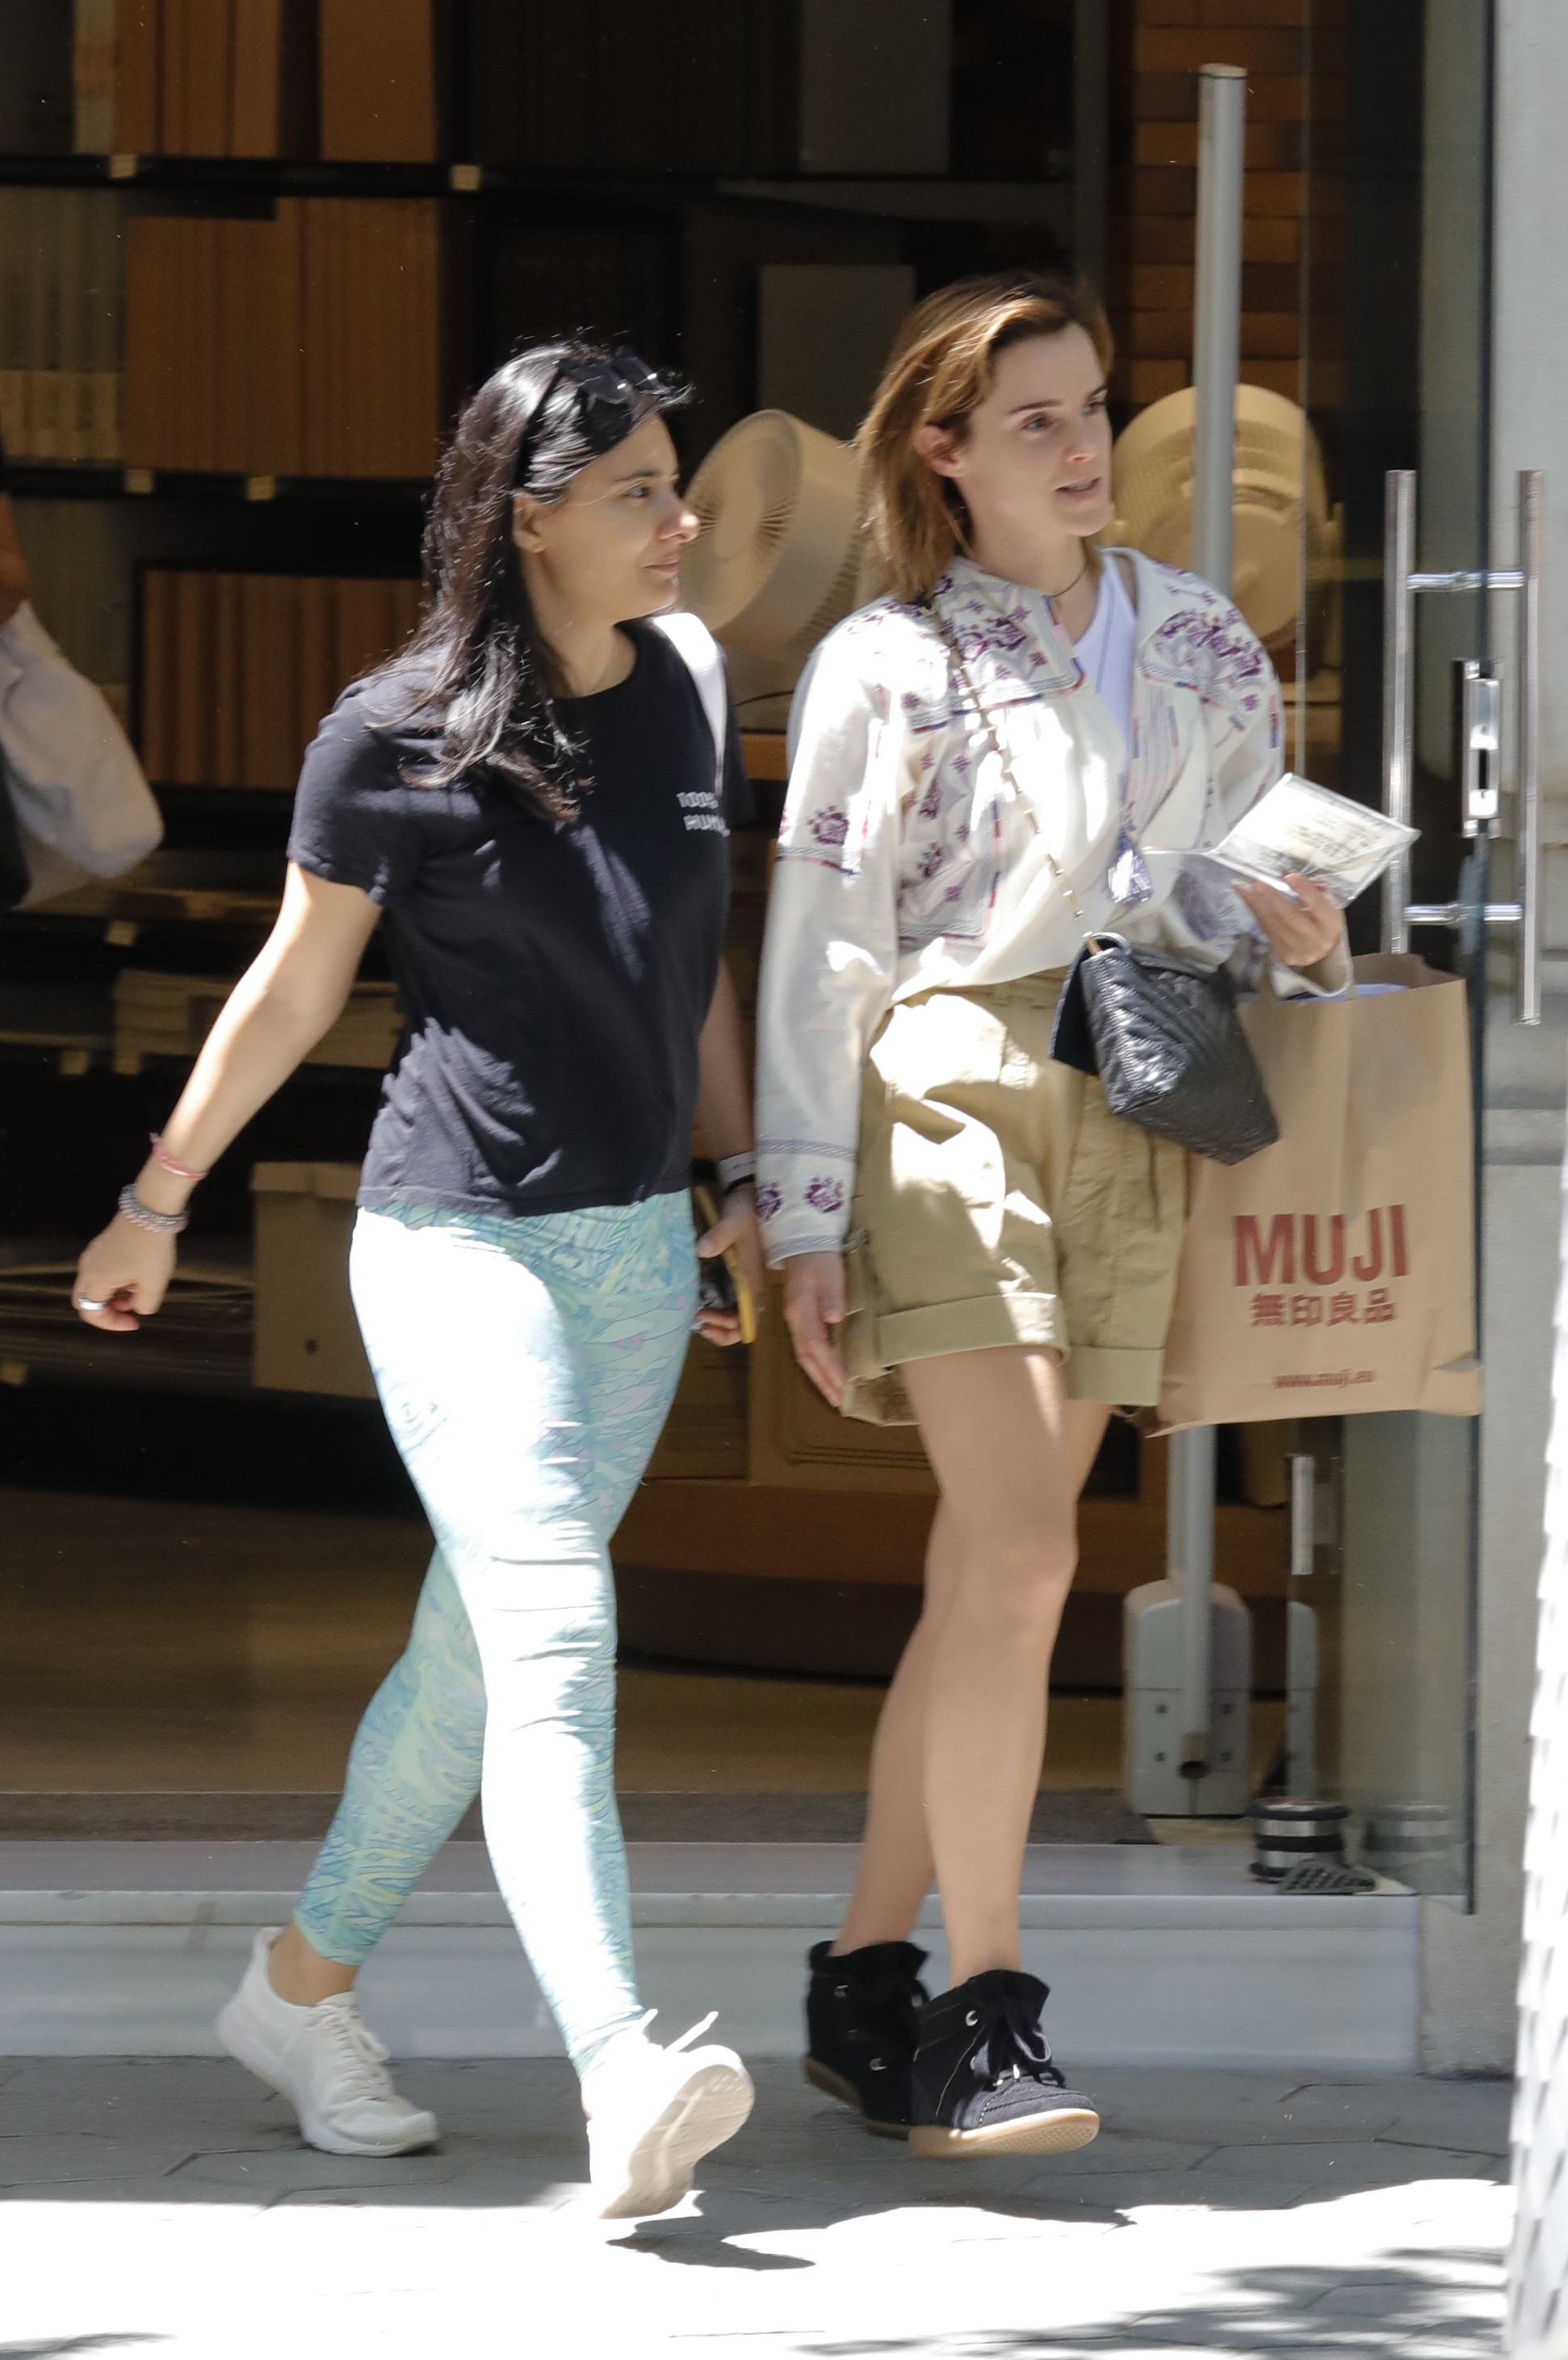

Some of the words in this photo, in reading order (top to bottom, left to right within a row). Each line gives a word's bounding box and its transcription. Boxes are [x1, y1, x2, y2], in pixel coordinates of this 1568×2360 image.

[1233, 1204, 1409, 1286] MUJI
[1251, 1288, 1396, 1327] 無印良品
